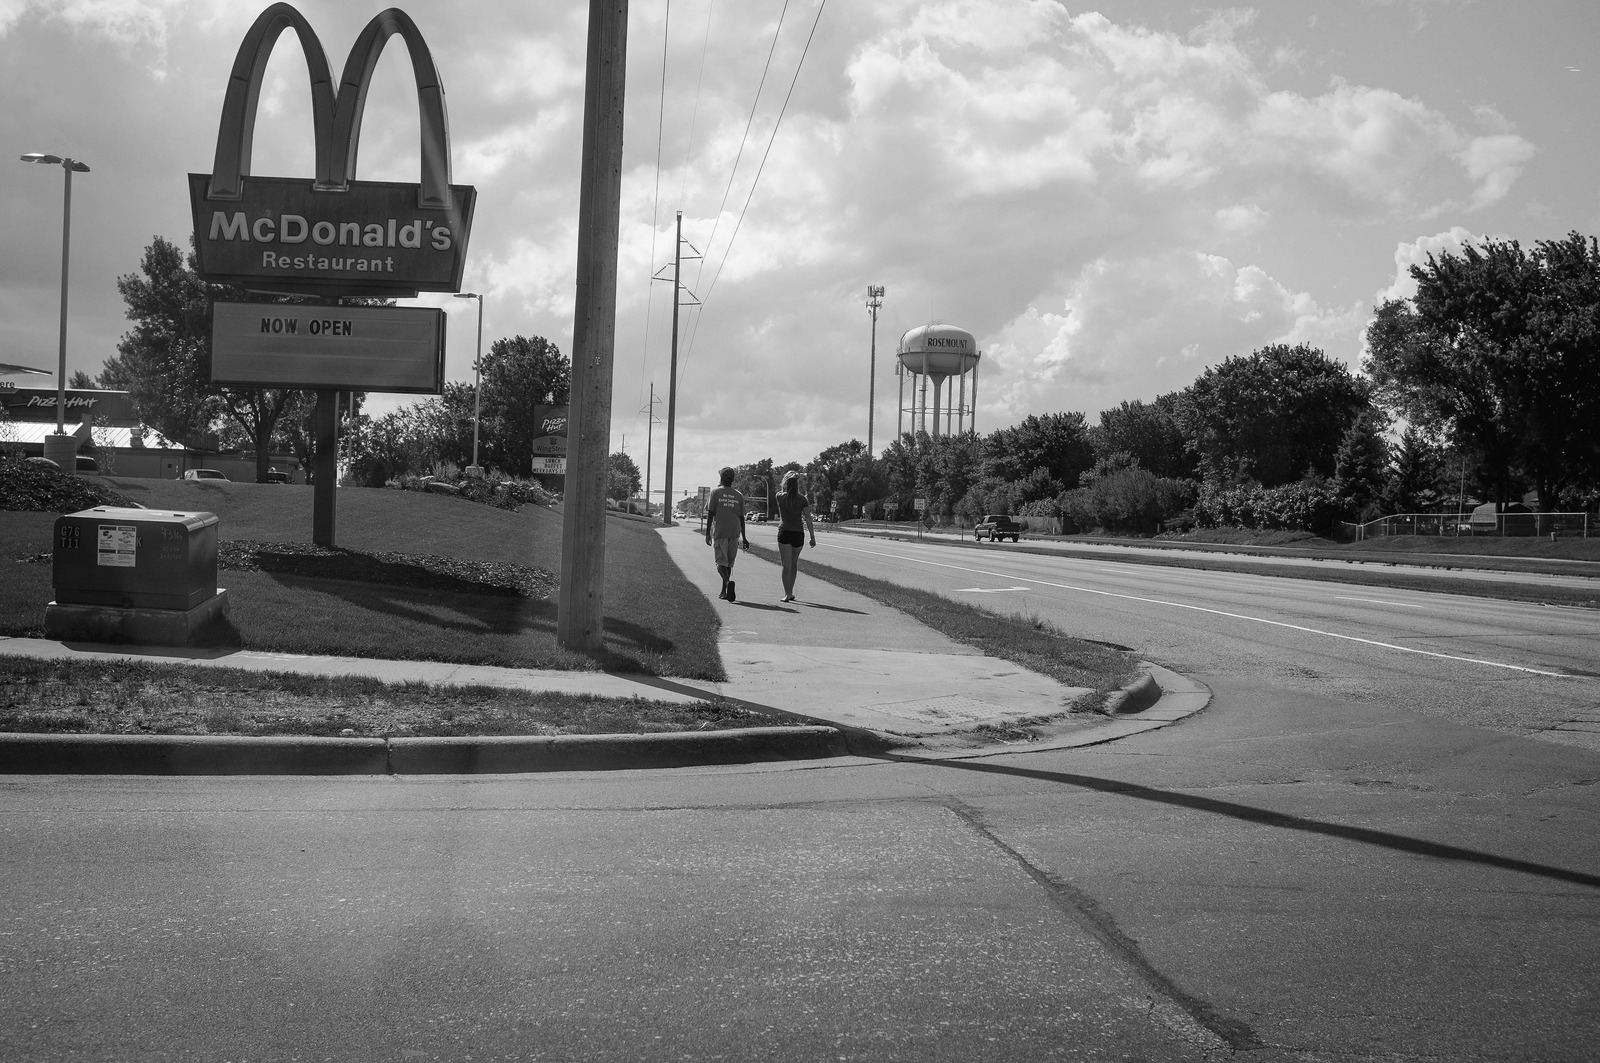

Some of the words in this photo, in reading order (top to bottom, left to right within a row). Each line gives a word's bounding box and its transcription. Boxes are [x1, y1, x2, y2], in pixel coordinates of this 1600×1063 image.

[208, 211, 452, 251] McDonald's
[262, 251, 394, 272] Restaurant
[261, 318, 298, 335] NOW
[309, 320, 352, 336] OPEN
[928, 338, 968, 348] ROSEMOUNT
[67, 397, 99, 408] Hut
[542, 418, 566, 429] Pizza
[546, 423, 564, 432] Hut
[61, 525, 80, 537] G76
[61, 537, 79, 549] T11
